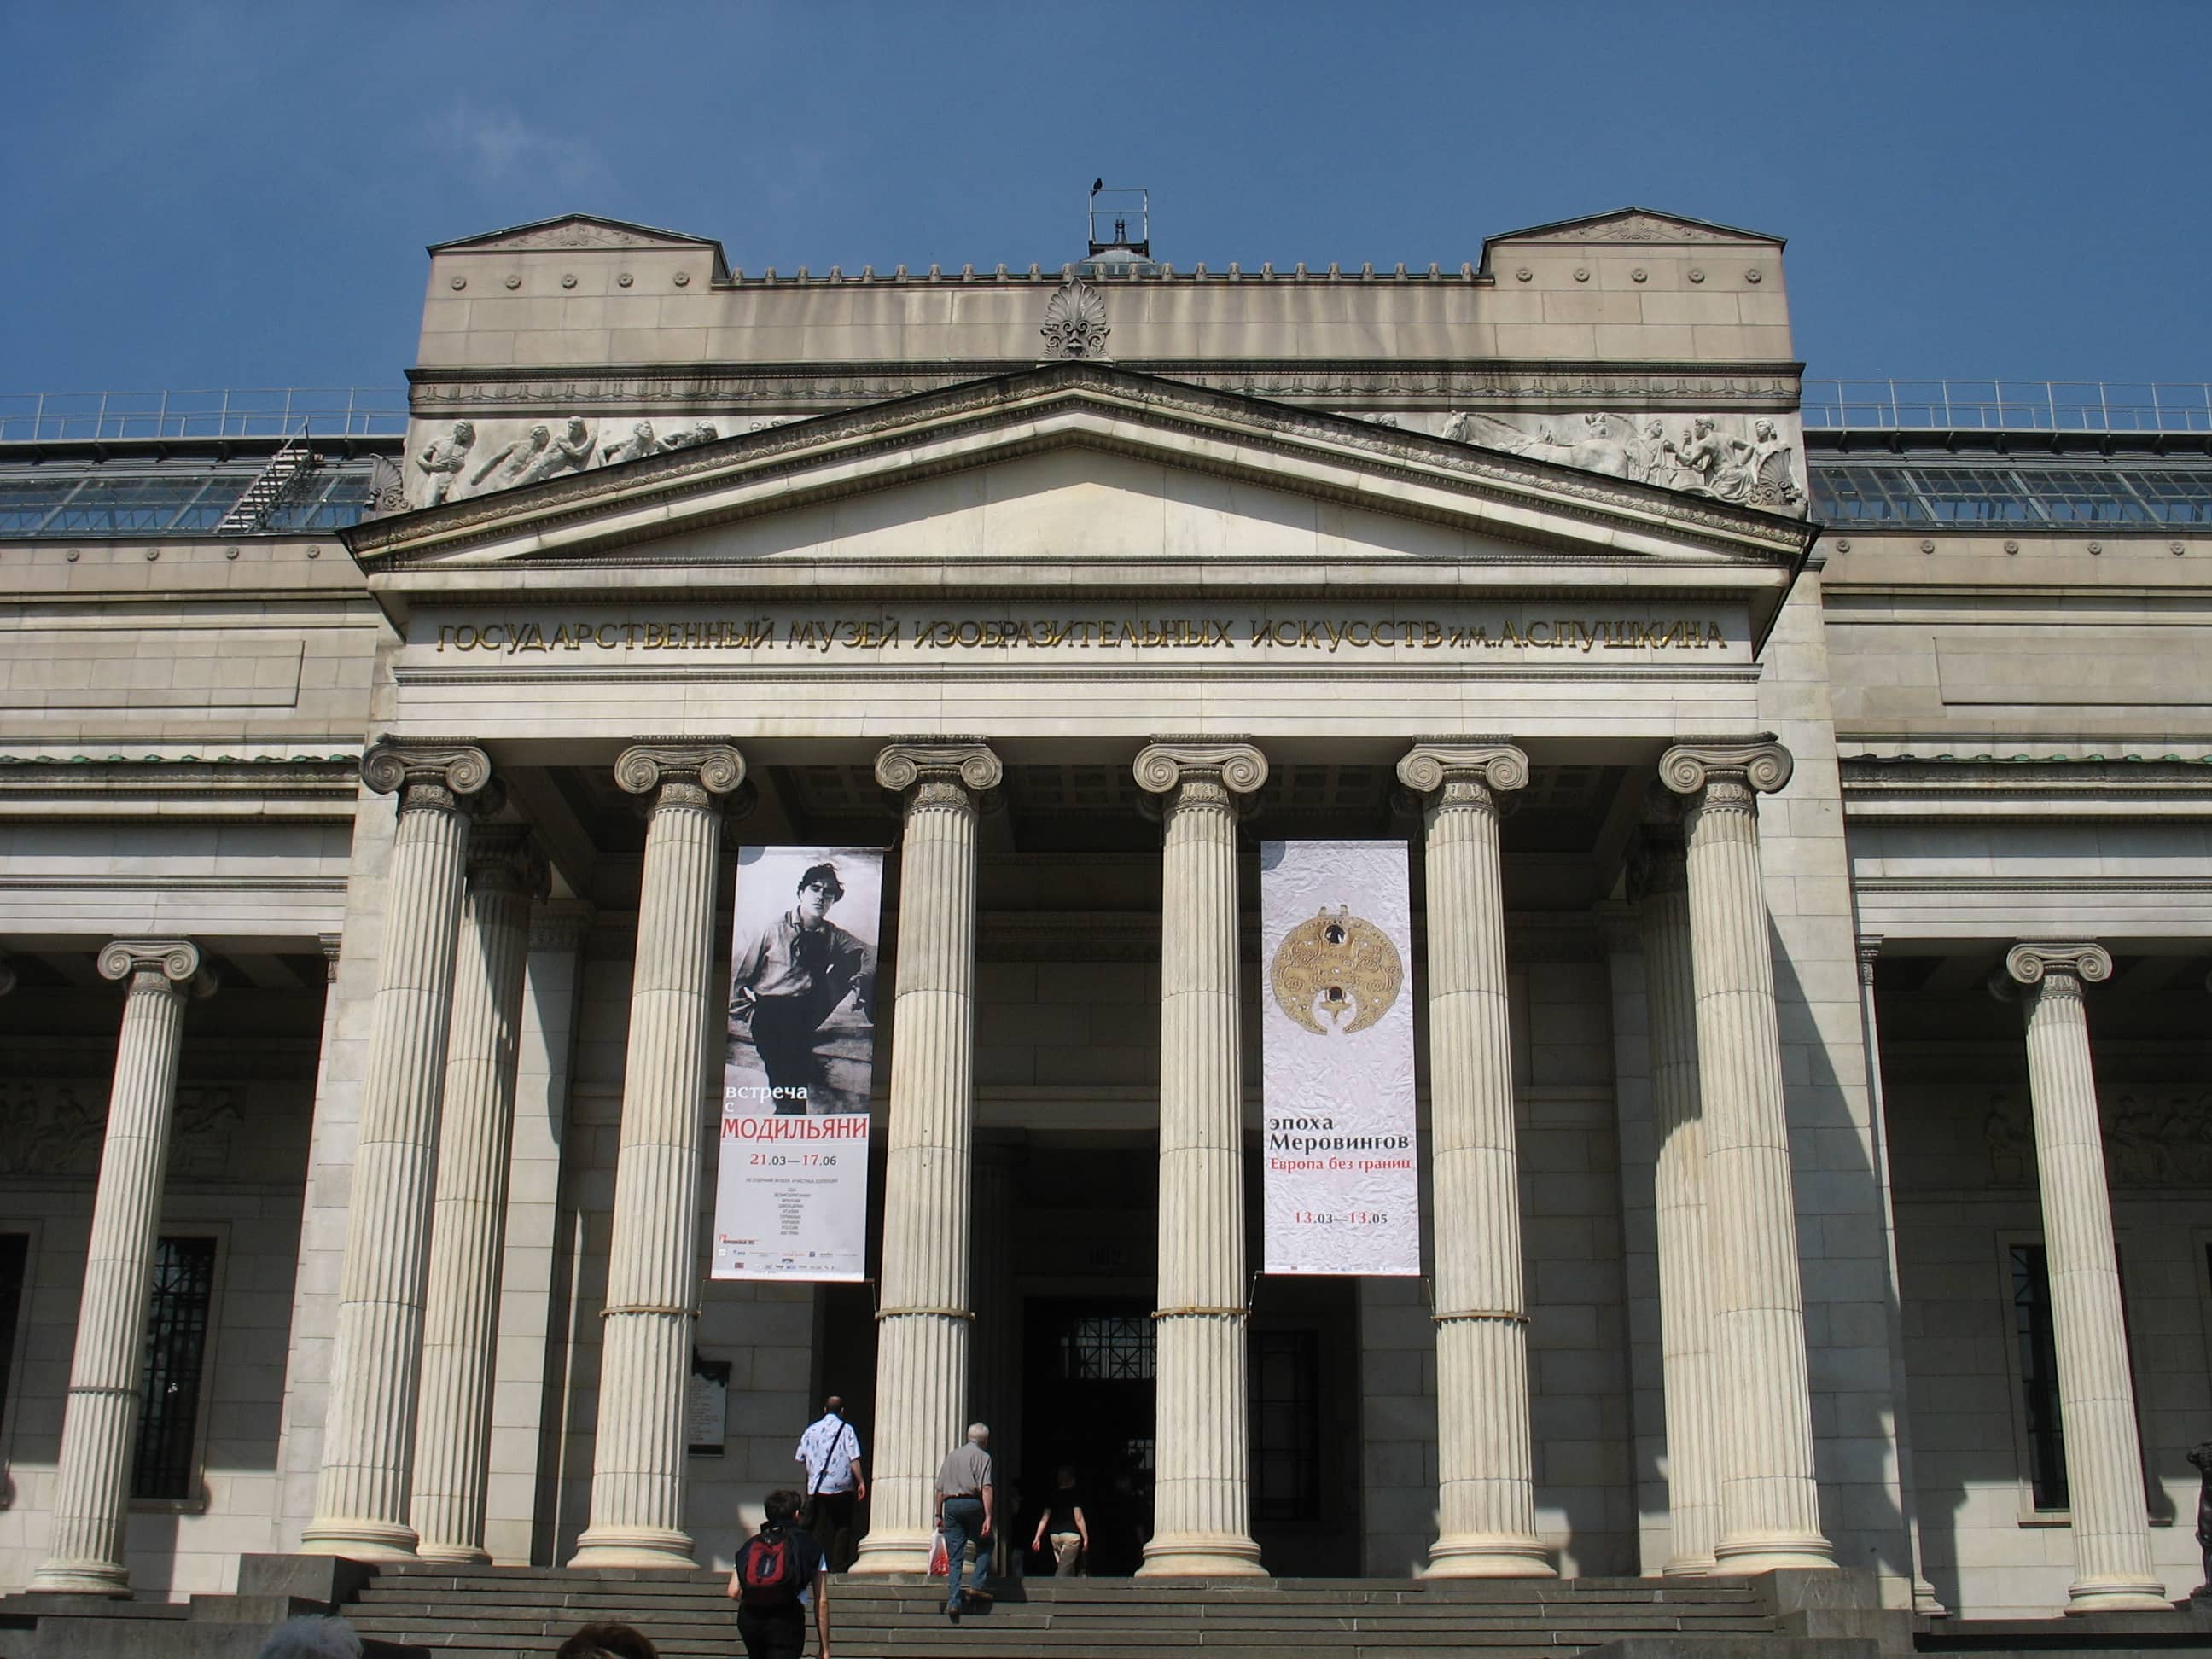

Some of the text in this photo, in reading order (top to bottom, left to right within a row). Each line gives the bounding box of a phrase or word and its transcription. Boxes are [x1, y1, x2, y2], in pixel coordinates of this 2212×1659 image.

[435, 615, 774, 655] ГОСУДАРСТВЕННЫЙ
[786, 615, 899, 654] МУЗЕЙ
[913, 620, 1235, 649] ИЗОБРАЗИТЕЛЬНЫХ
[1249, 620, 1443, 653] ИСКУССТВ
[725, 1086, 808, 1103] встреча
[725, 1101, 735, 1113] с
[721, 1117, 868, 1144] МОДИЛЬЯНИ
[1269, 1117, 1334, 1131] эпоха
[1269, 1133, 1410, 1155] Меровингов
[1270, 1156, 1412, 1173] Европа без границ
